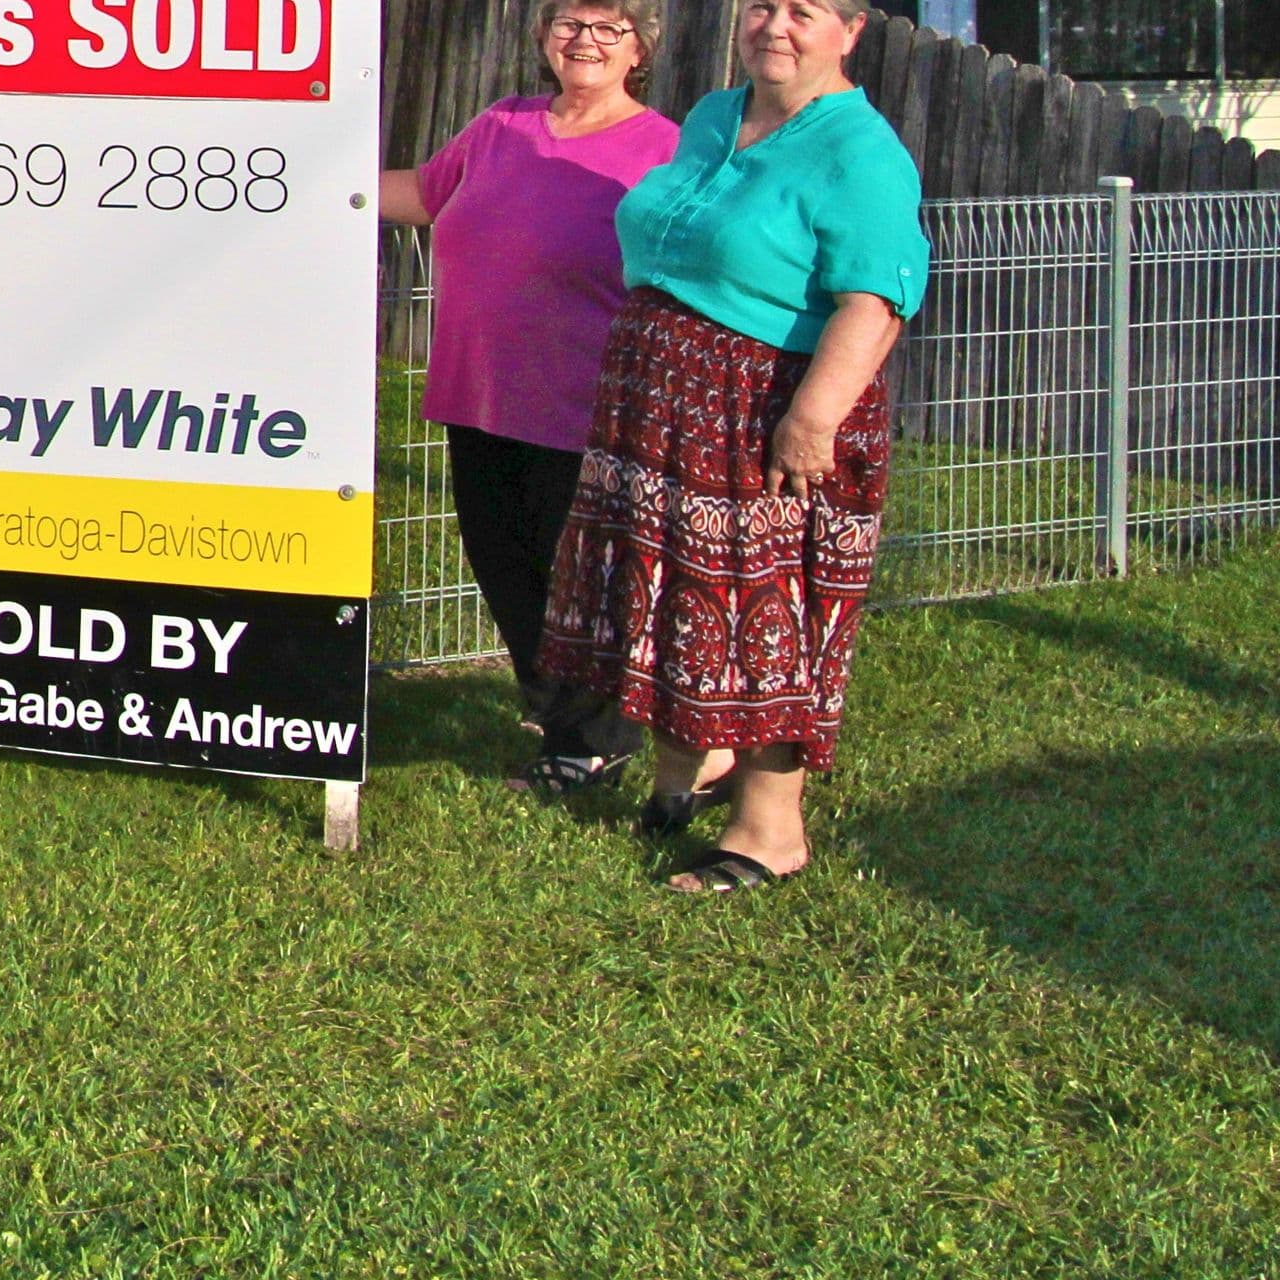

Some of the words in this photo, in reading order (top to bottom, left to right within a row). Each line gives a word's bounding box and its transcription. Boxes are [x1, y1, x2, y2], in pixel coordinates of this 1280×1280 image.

[97, 144, 289, 214] 2888
[90, 386, 307, 459] White
[150, 614, 249, 674] BY
[118, 692, 154, 737] &
[164, 697, 357, 755] Andrew
